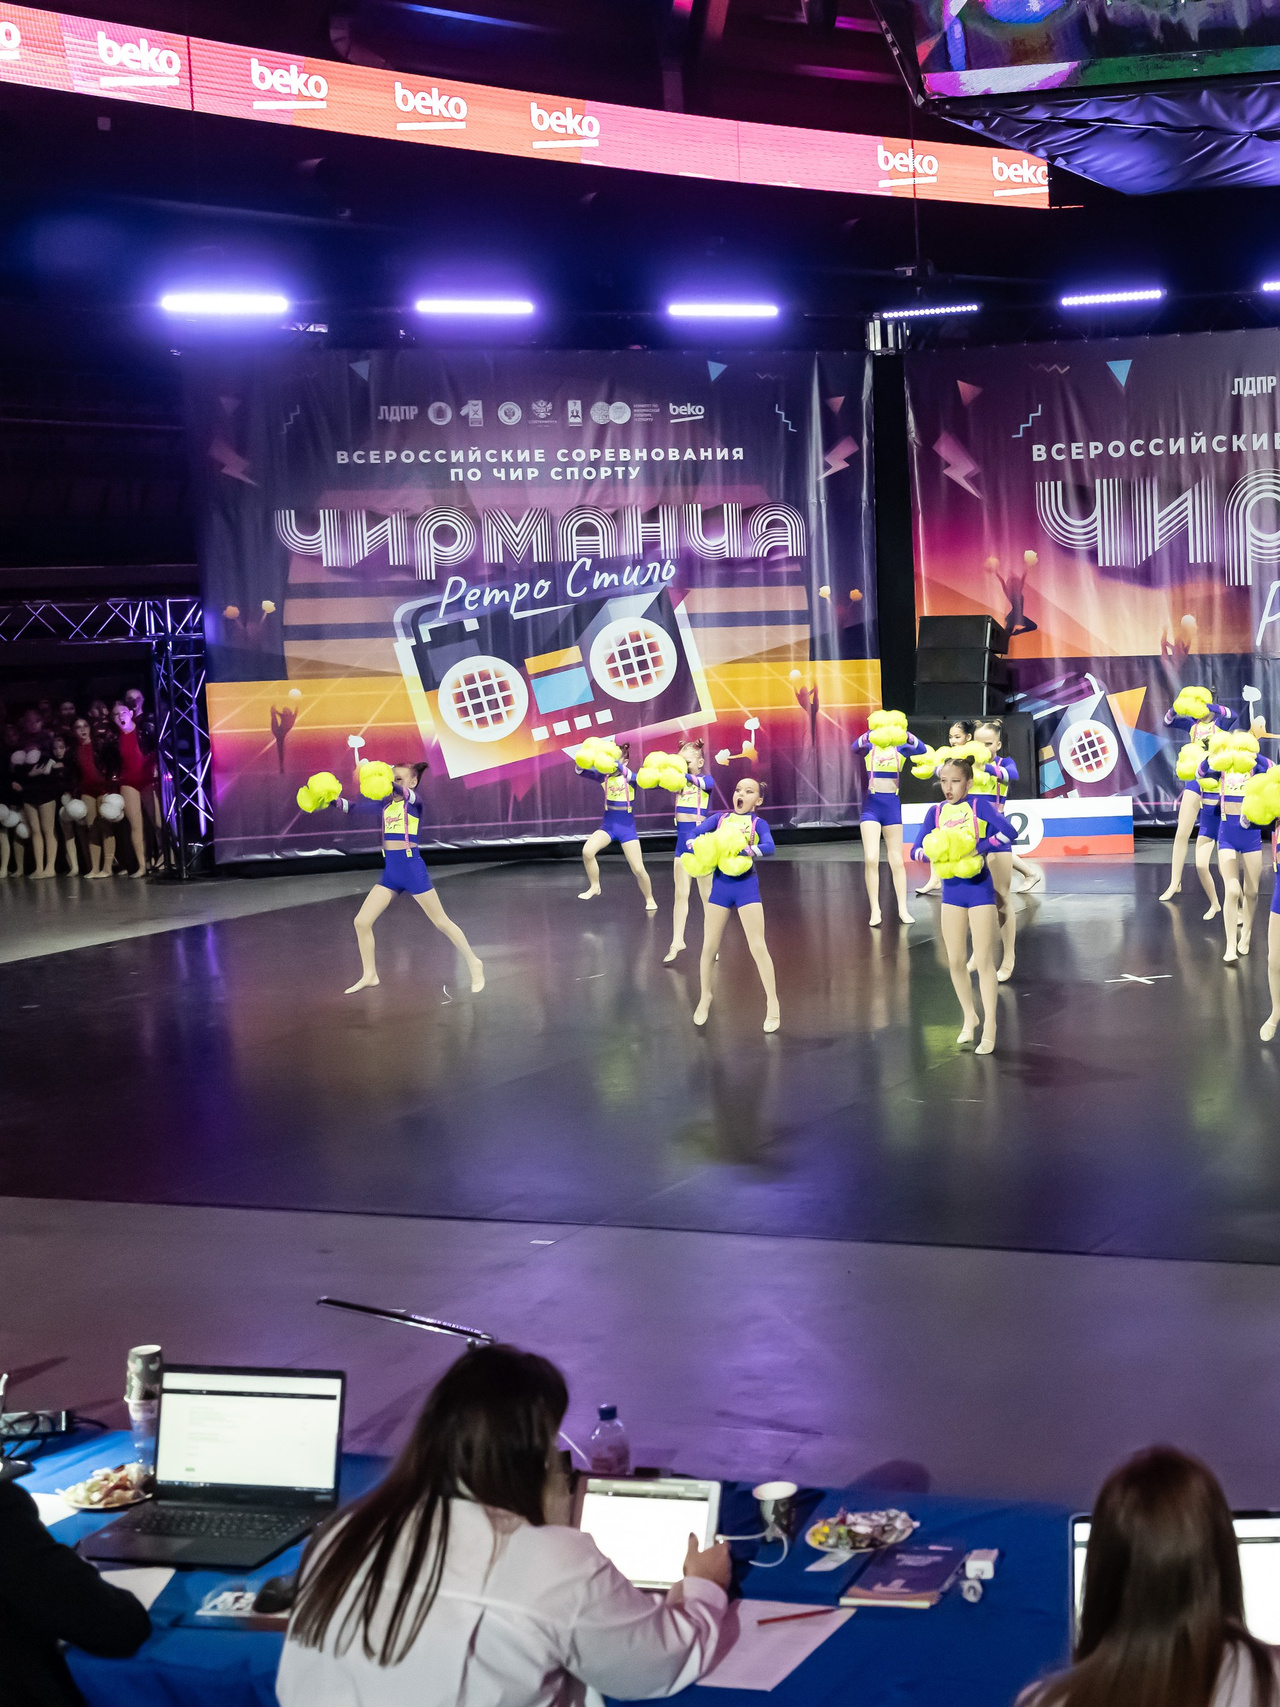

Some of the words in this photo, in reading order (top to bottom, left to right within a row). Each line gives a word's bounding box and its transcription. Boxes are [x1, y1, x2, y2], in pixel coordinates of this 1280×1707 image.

[97, 31, 181, 76] beko
[250, 58, 328, 100] beko
[394, 82, 468, 121] beko
[530, 102, 600, 139] beko
[877, 144, 939, 175] beko
[1231, 375, 1277, 397] ЛДПР
[377, 404, 419, 421] ЛДПР
[669, 402, 705, 416] beko
[336, 446, 546, 464] ВСЕРОССИЙСКИЕ
[557, 447, 745, 462] СОРЕВНОВАНИЯ
[450, 468, 482, 481] ПО
[493, 467, 539, 481] ЧИР
[550, 466, 641, 481] СПОРТУ
[439, 576, 551, 618] Ретро
[566, 557, 676, 597] Стиль
